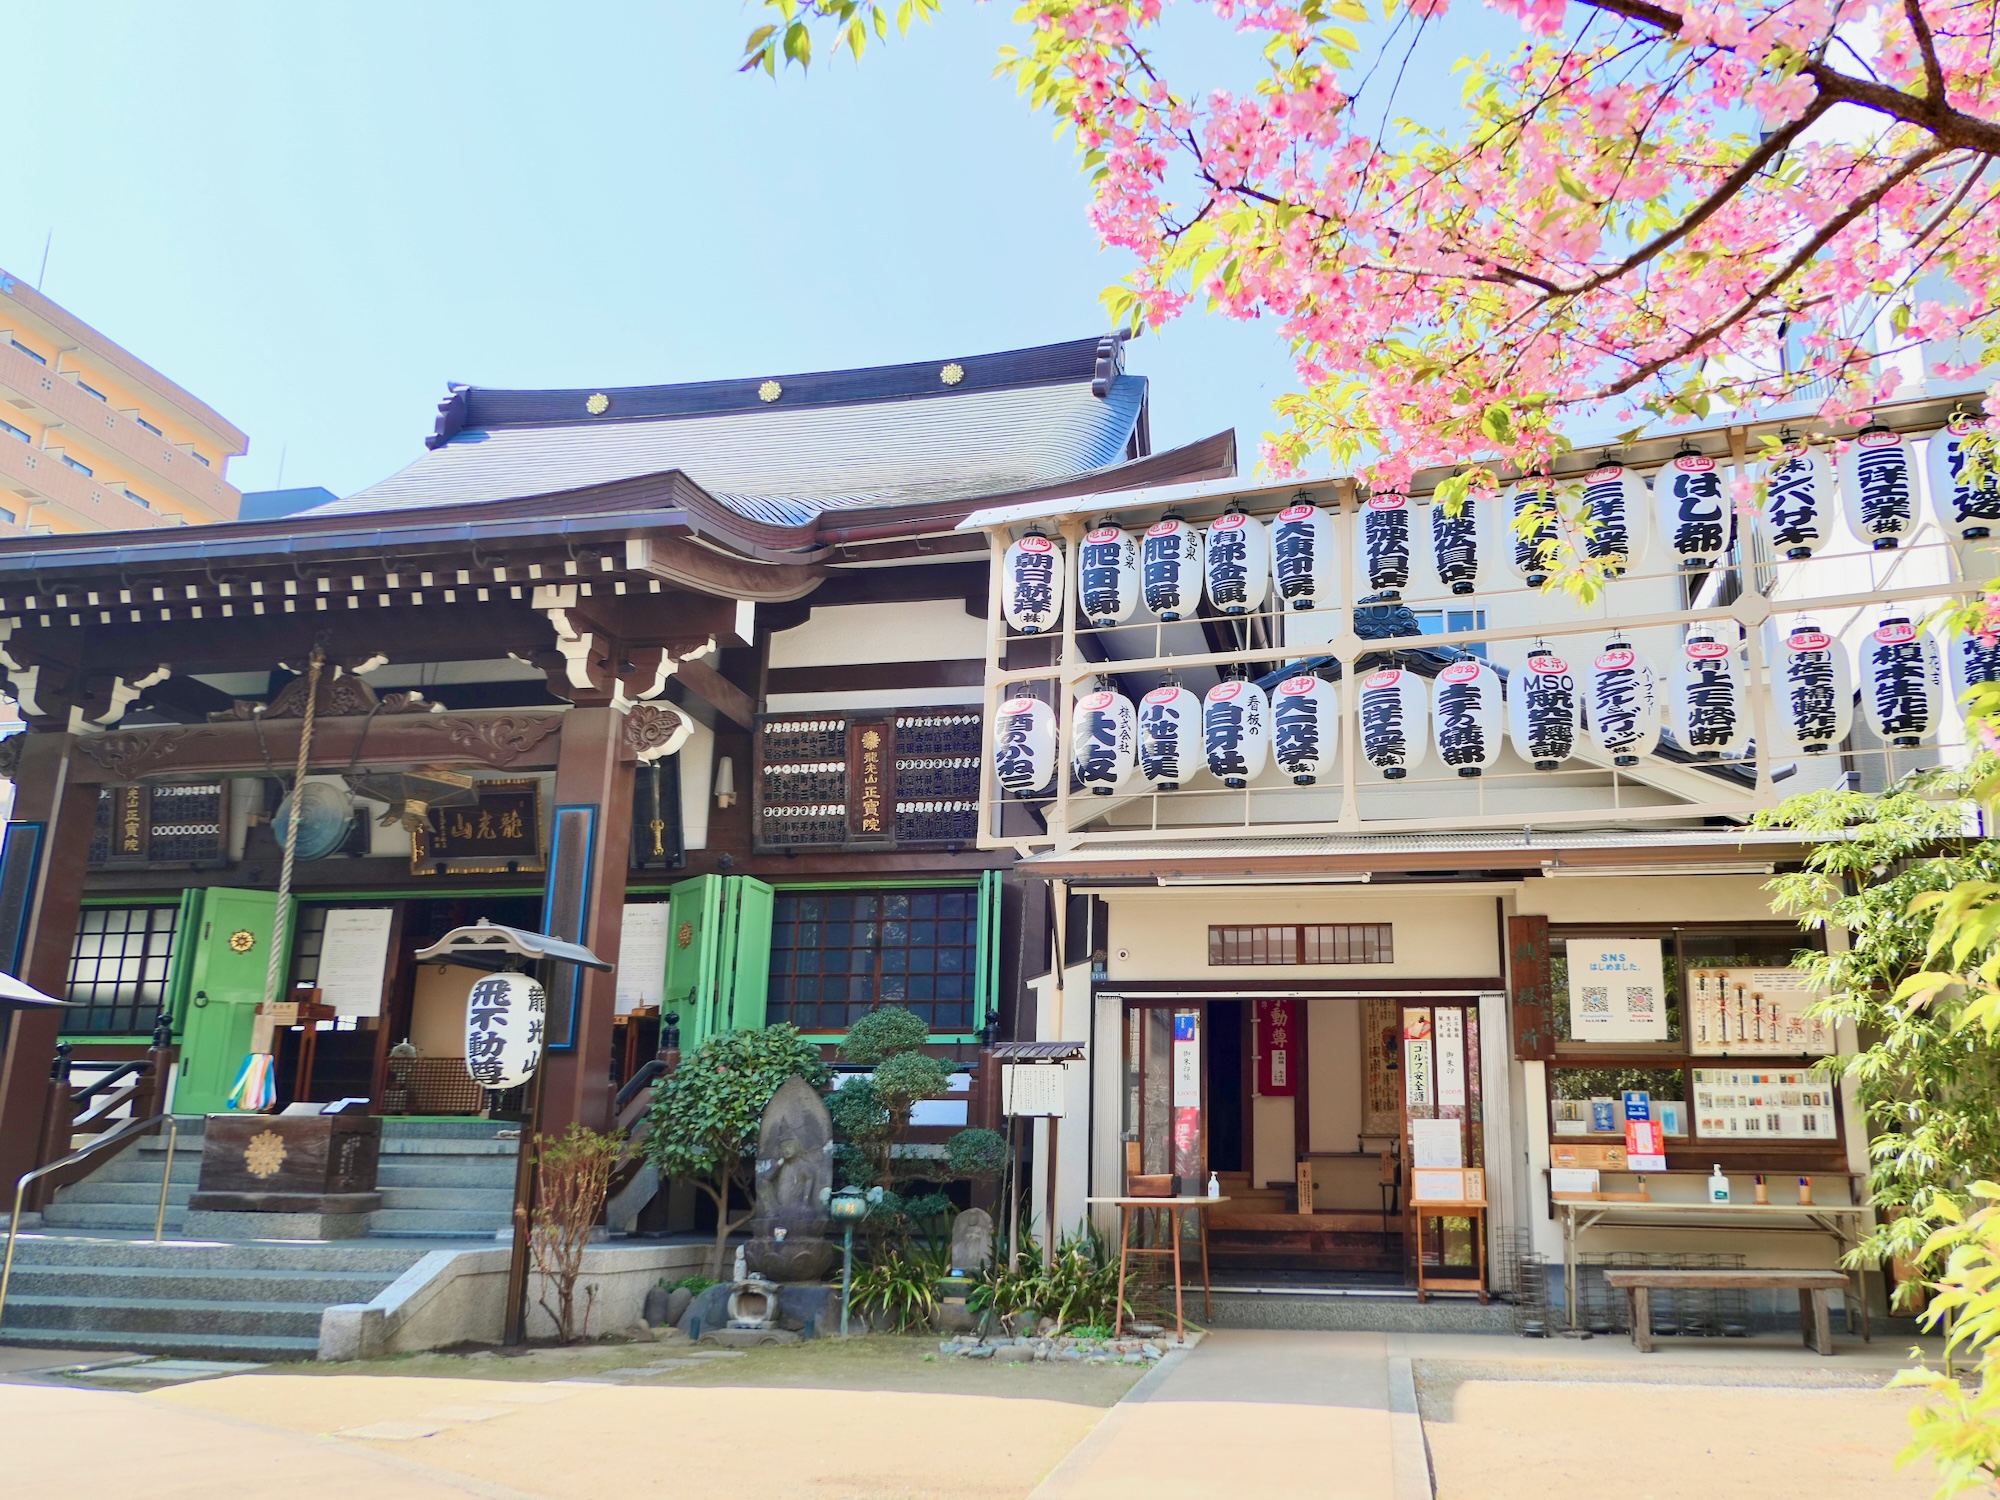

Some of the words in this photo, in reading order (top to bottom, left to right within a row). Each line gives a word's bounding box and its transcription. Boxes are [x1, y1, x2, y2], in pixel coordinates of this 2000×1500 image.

[1082, 543, 1121, 616] 肥田野
[1144, 535, 1182, 613] 肥田野
[1523, 674, 1574, 692] MSO
[1534, 657, 1564, 669] 東京
[1118, 705, 1132, 755] 株式会社
[1246, 694, 1263, 736] 看板の
[1589, 963, 1641, 971] はじめました。
[1600, 953, 1627, 962] SNS
[468, 979, 512, 1085] 飛不動尊
